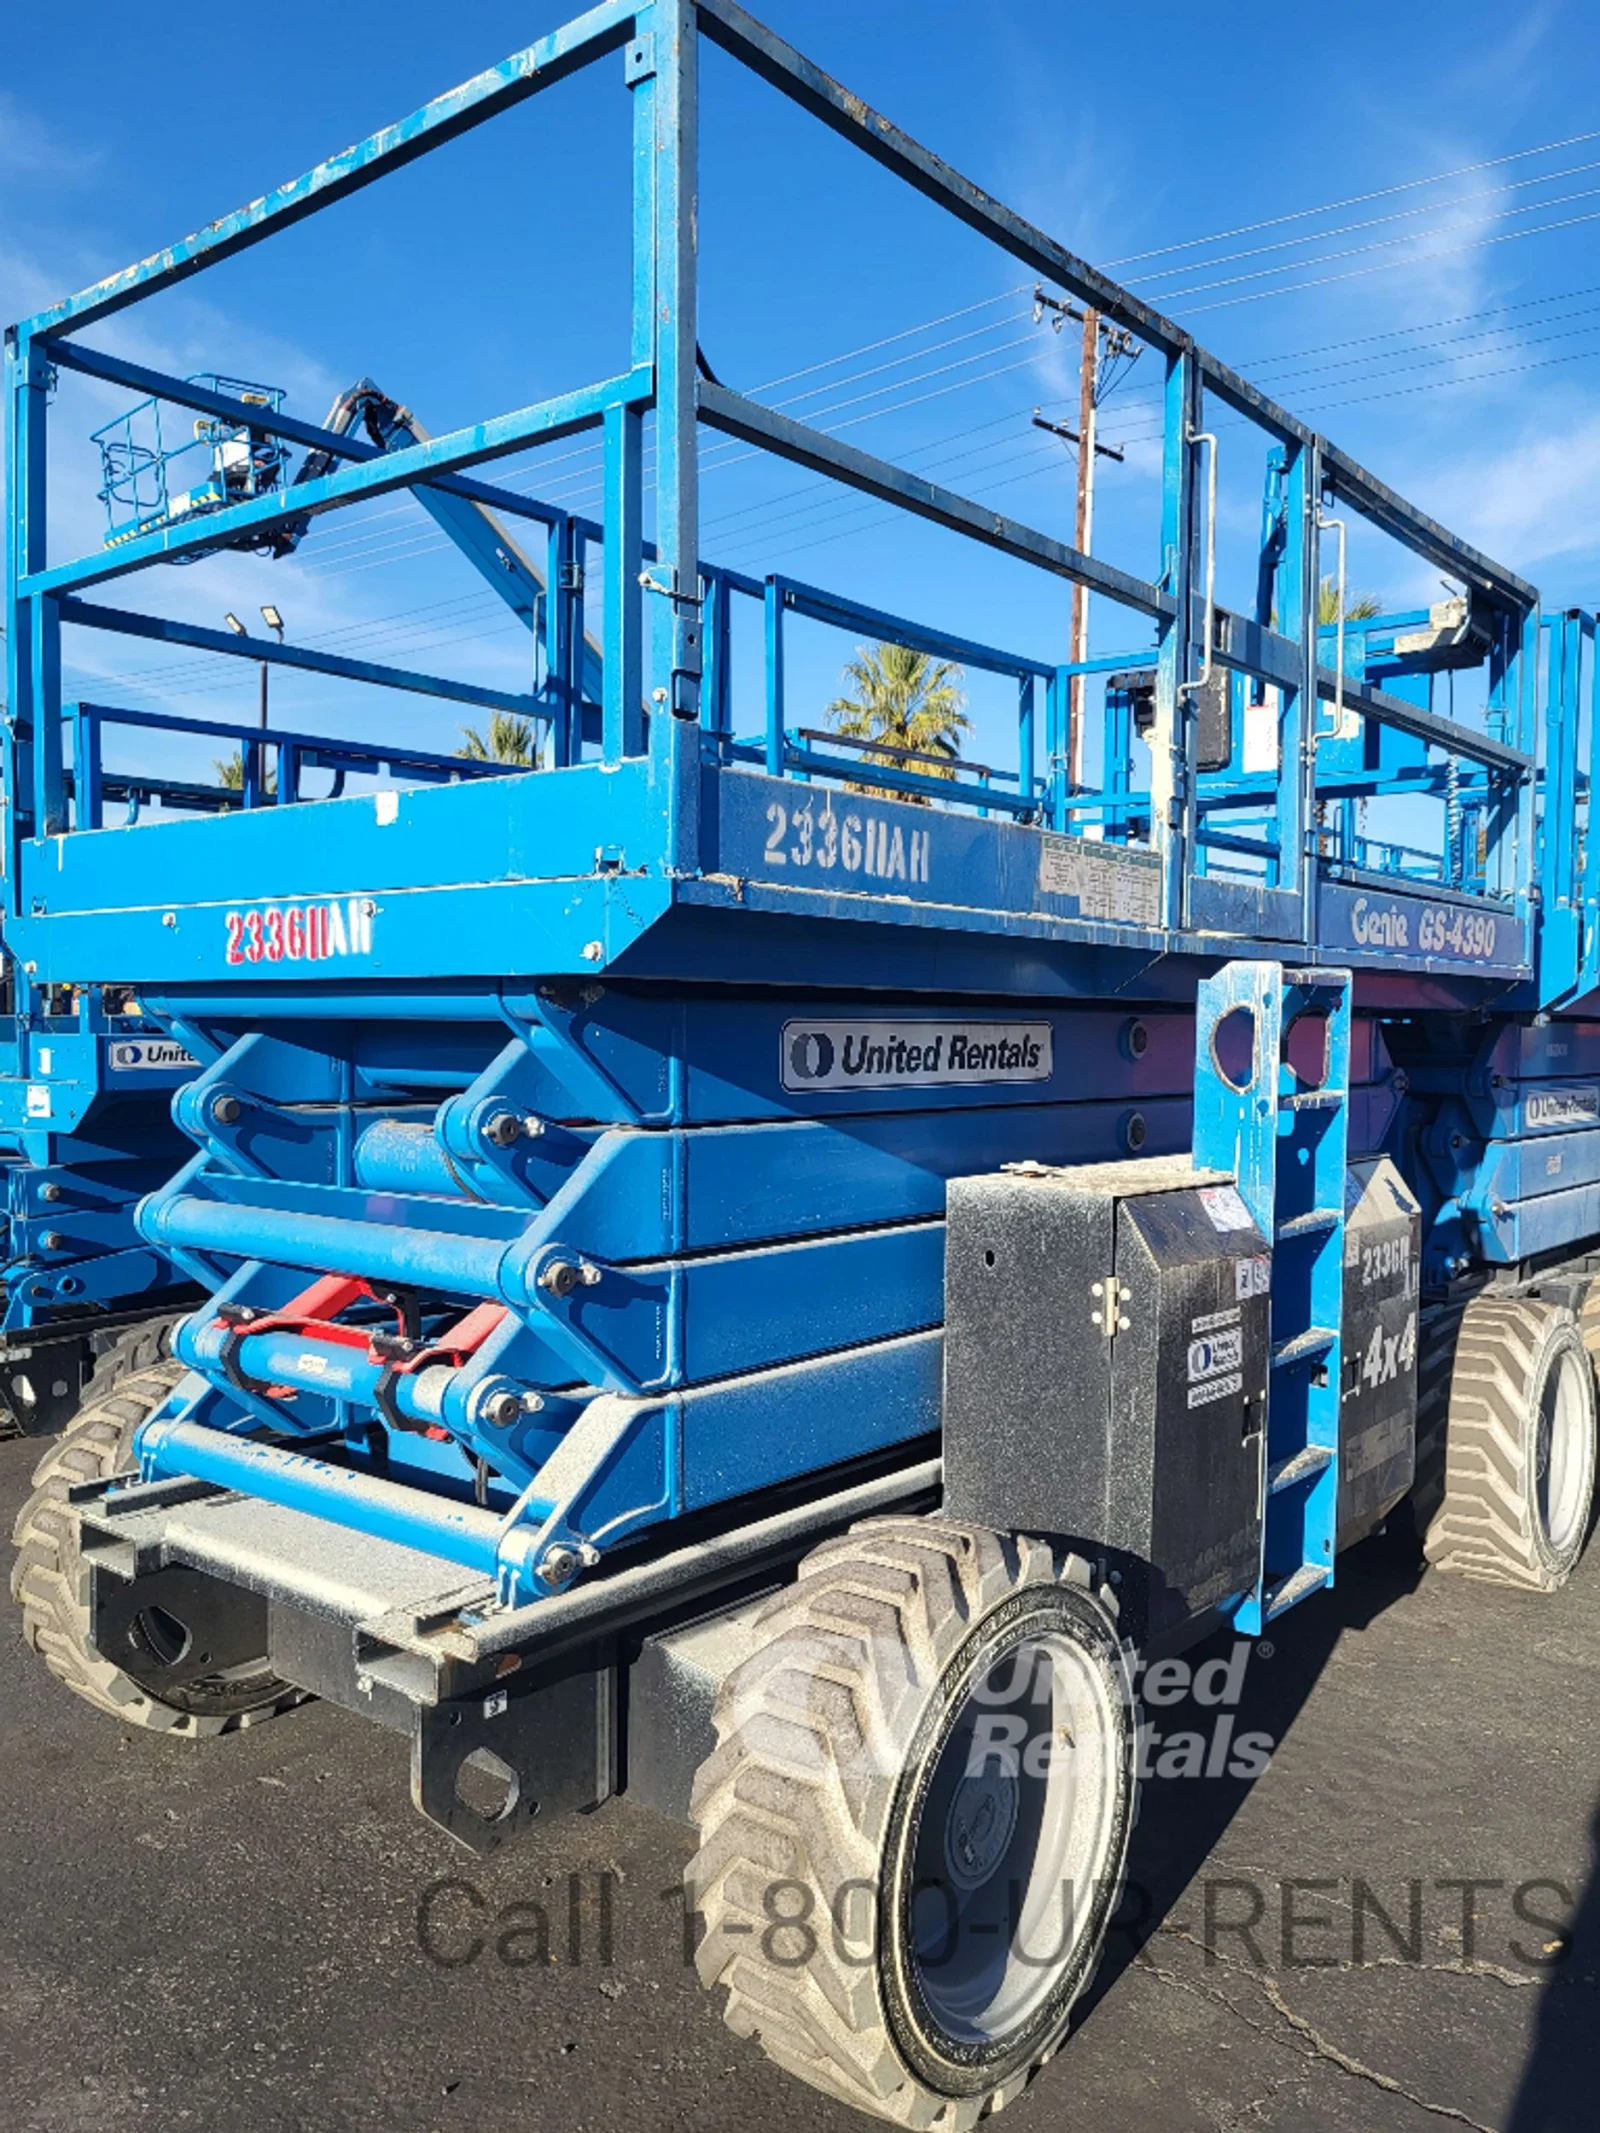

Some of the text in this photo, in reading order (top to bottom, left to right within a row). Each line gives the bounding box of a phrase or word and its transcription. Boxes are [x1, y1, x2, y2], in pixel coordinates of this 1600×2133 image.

[1352, 898, 1496, 957] Genie GS-4390
[842, 1033, 1041, 1076] United Rentals
[1363, 1312, 1417, 1388] 4x4
